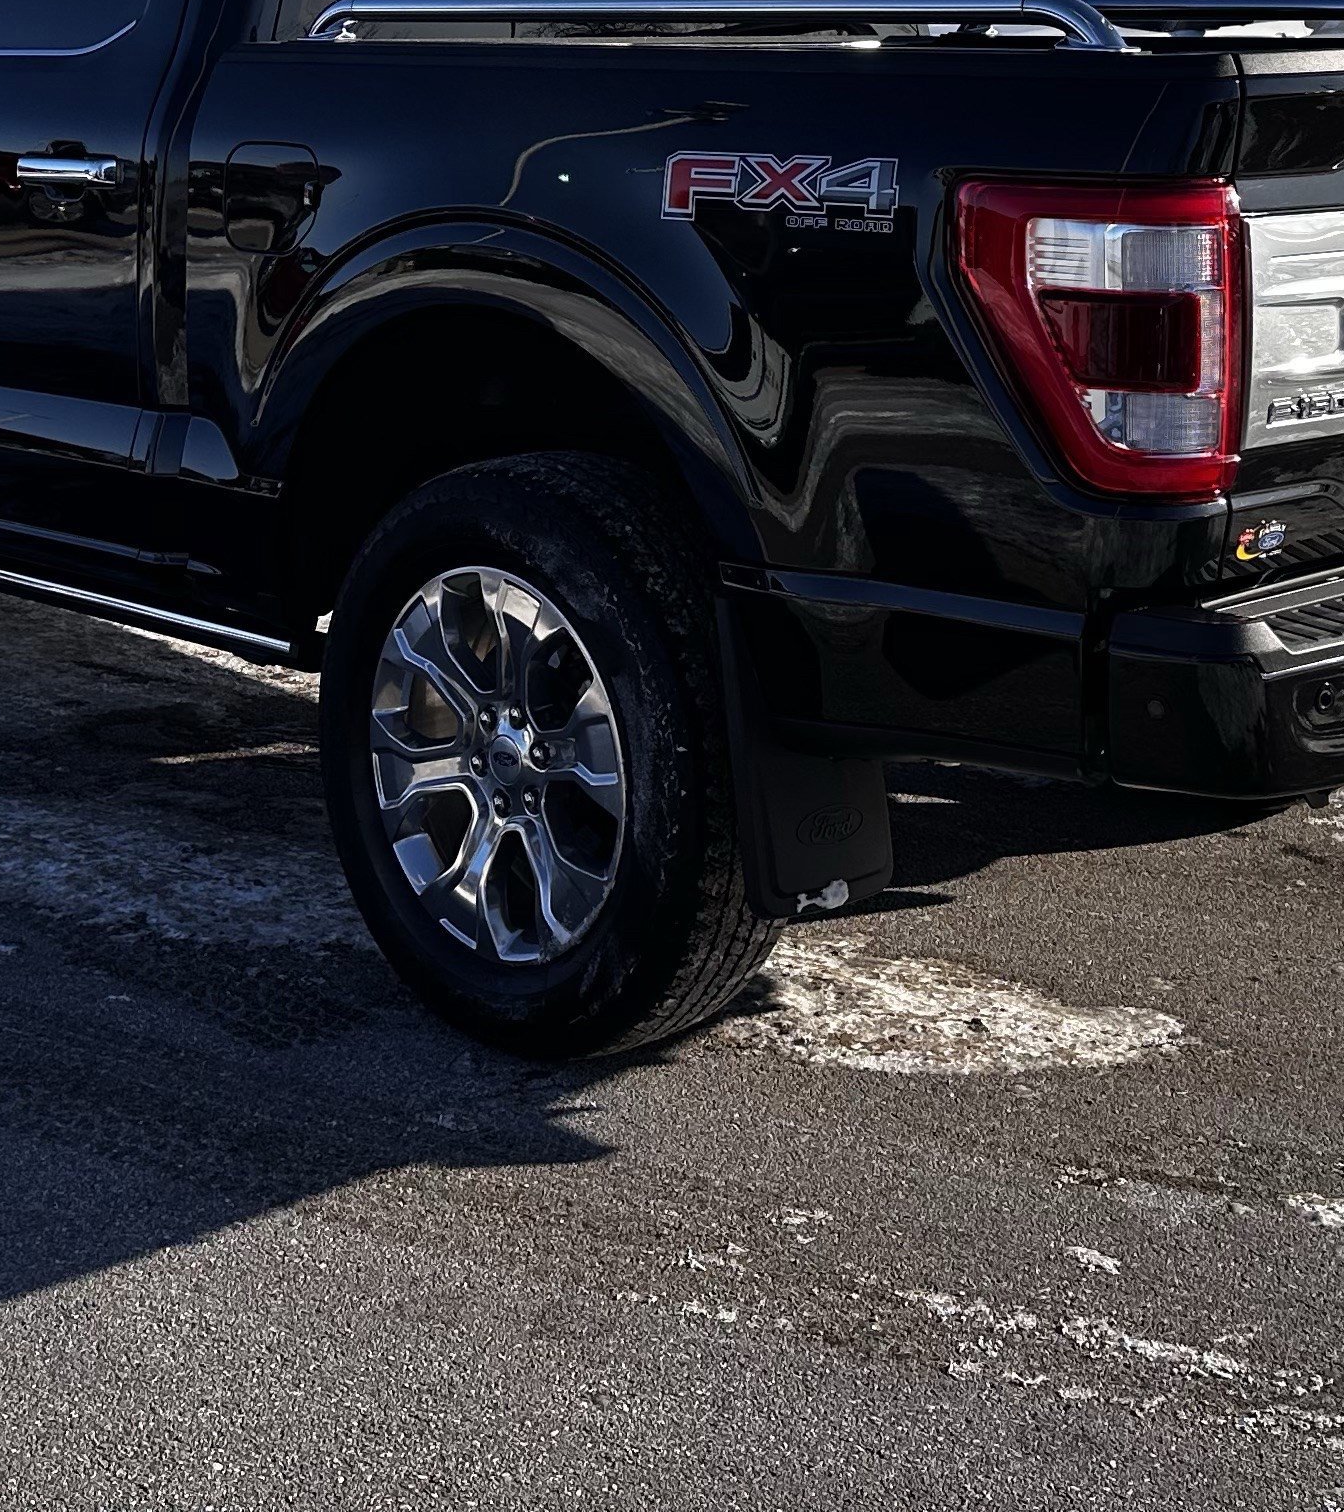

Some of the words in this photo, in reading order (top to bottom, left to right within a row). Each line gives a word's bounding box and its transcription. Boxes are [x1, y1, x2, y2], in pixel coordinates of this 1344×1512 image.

[661, 151, 899, 221] FX4
[786, 215, 828, 229] OFF
[834, 218, 894, 234] ROAD
